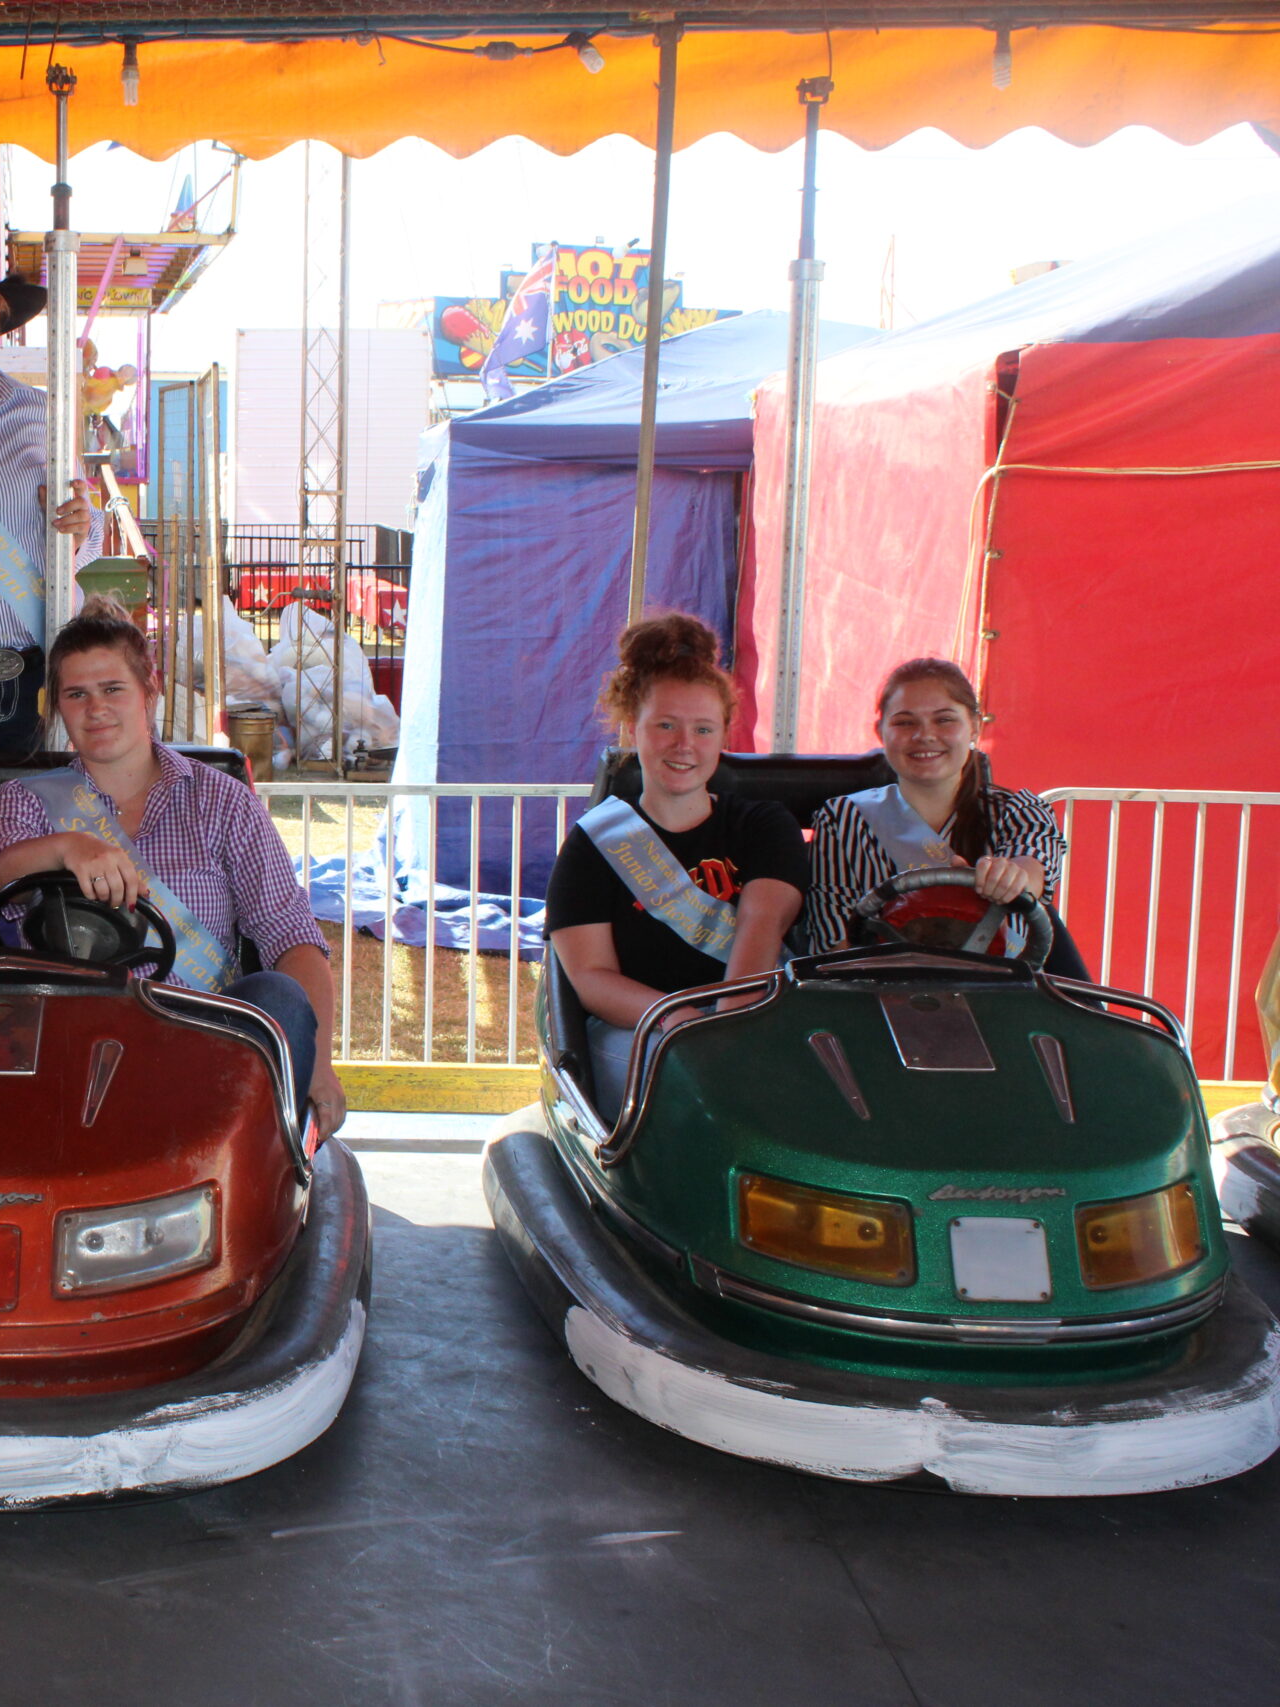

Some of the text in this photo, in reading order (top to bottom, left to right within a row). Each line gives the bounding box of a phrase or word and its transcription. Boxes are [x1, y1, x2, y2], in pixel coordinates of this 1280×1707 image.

[554, 249, 651, 282] HOT
[553, 275, 638, 305] FOOD
[553, 309, 615, 333] WOOD
[608, 841, 736, 949] Junior Showgirl
[642, 841, 683, 892] Narrabri
[682, 888, 718, 917] Show
[169, 906, 203, 948] Society
